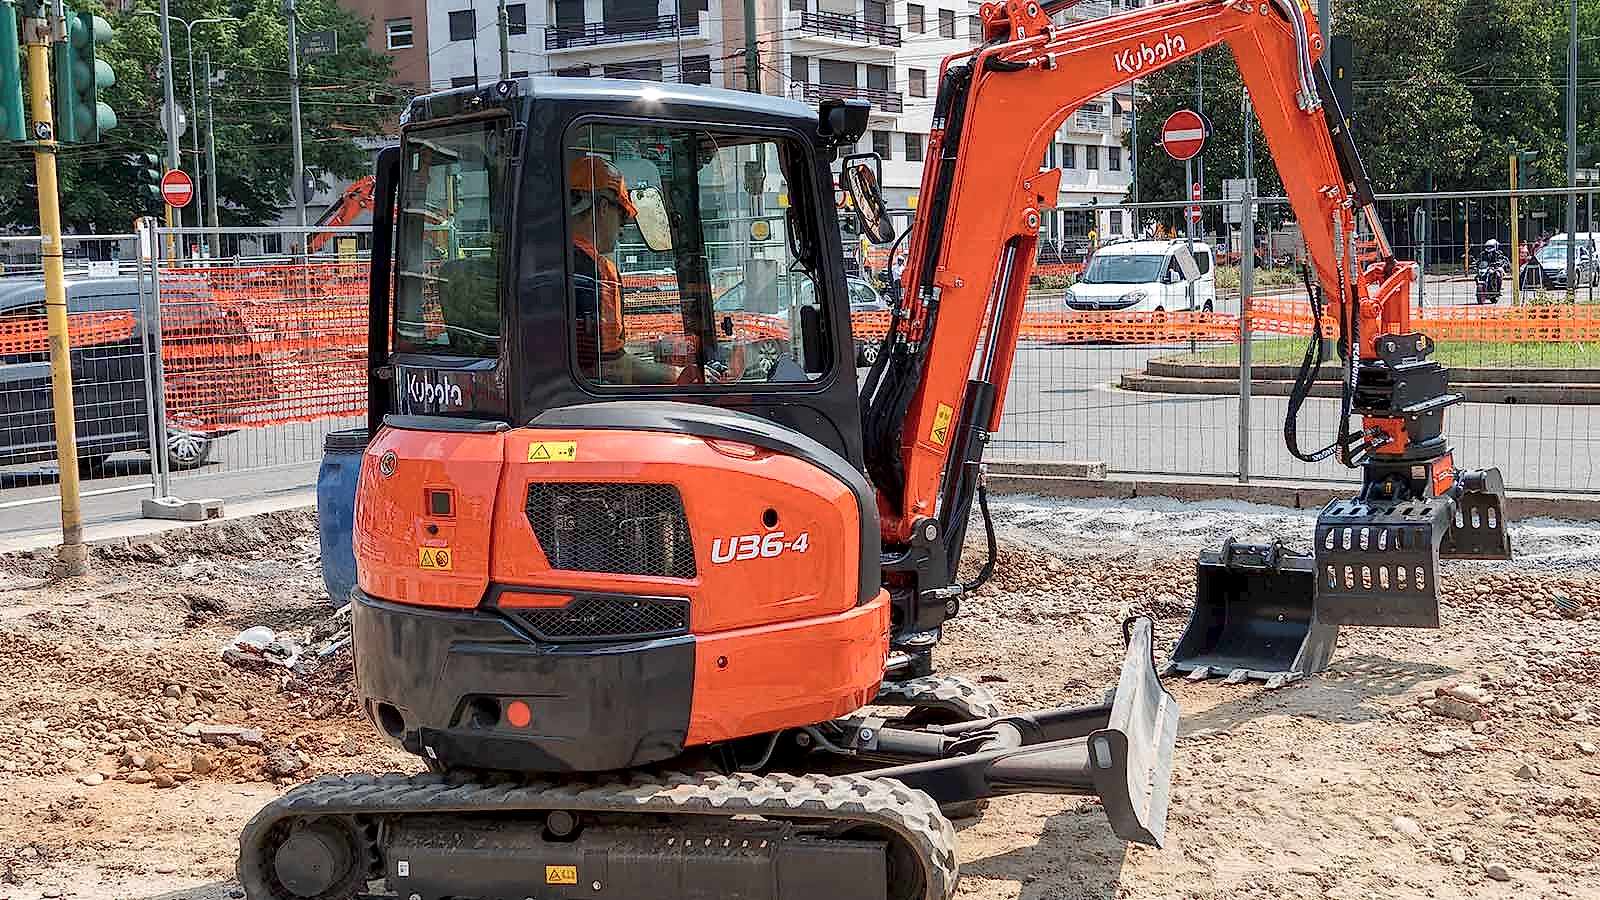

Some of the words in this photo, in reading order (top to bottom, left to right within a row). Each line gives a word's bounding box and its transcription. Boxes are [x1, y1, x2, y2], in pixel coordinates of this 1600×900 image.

[1114, 33, 1186, 73] Kubota
[407, 373, 462, 406] Kubota
[711, 531, 809, 564] U36-4
